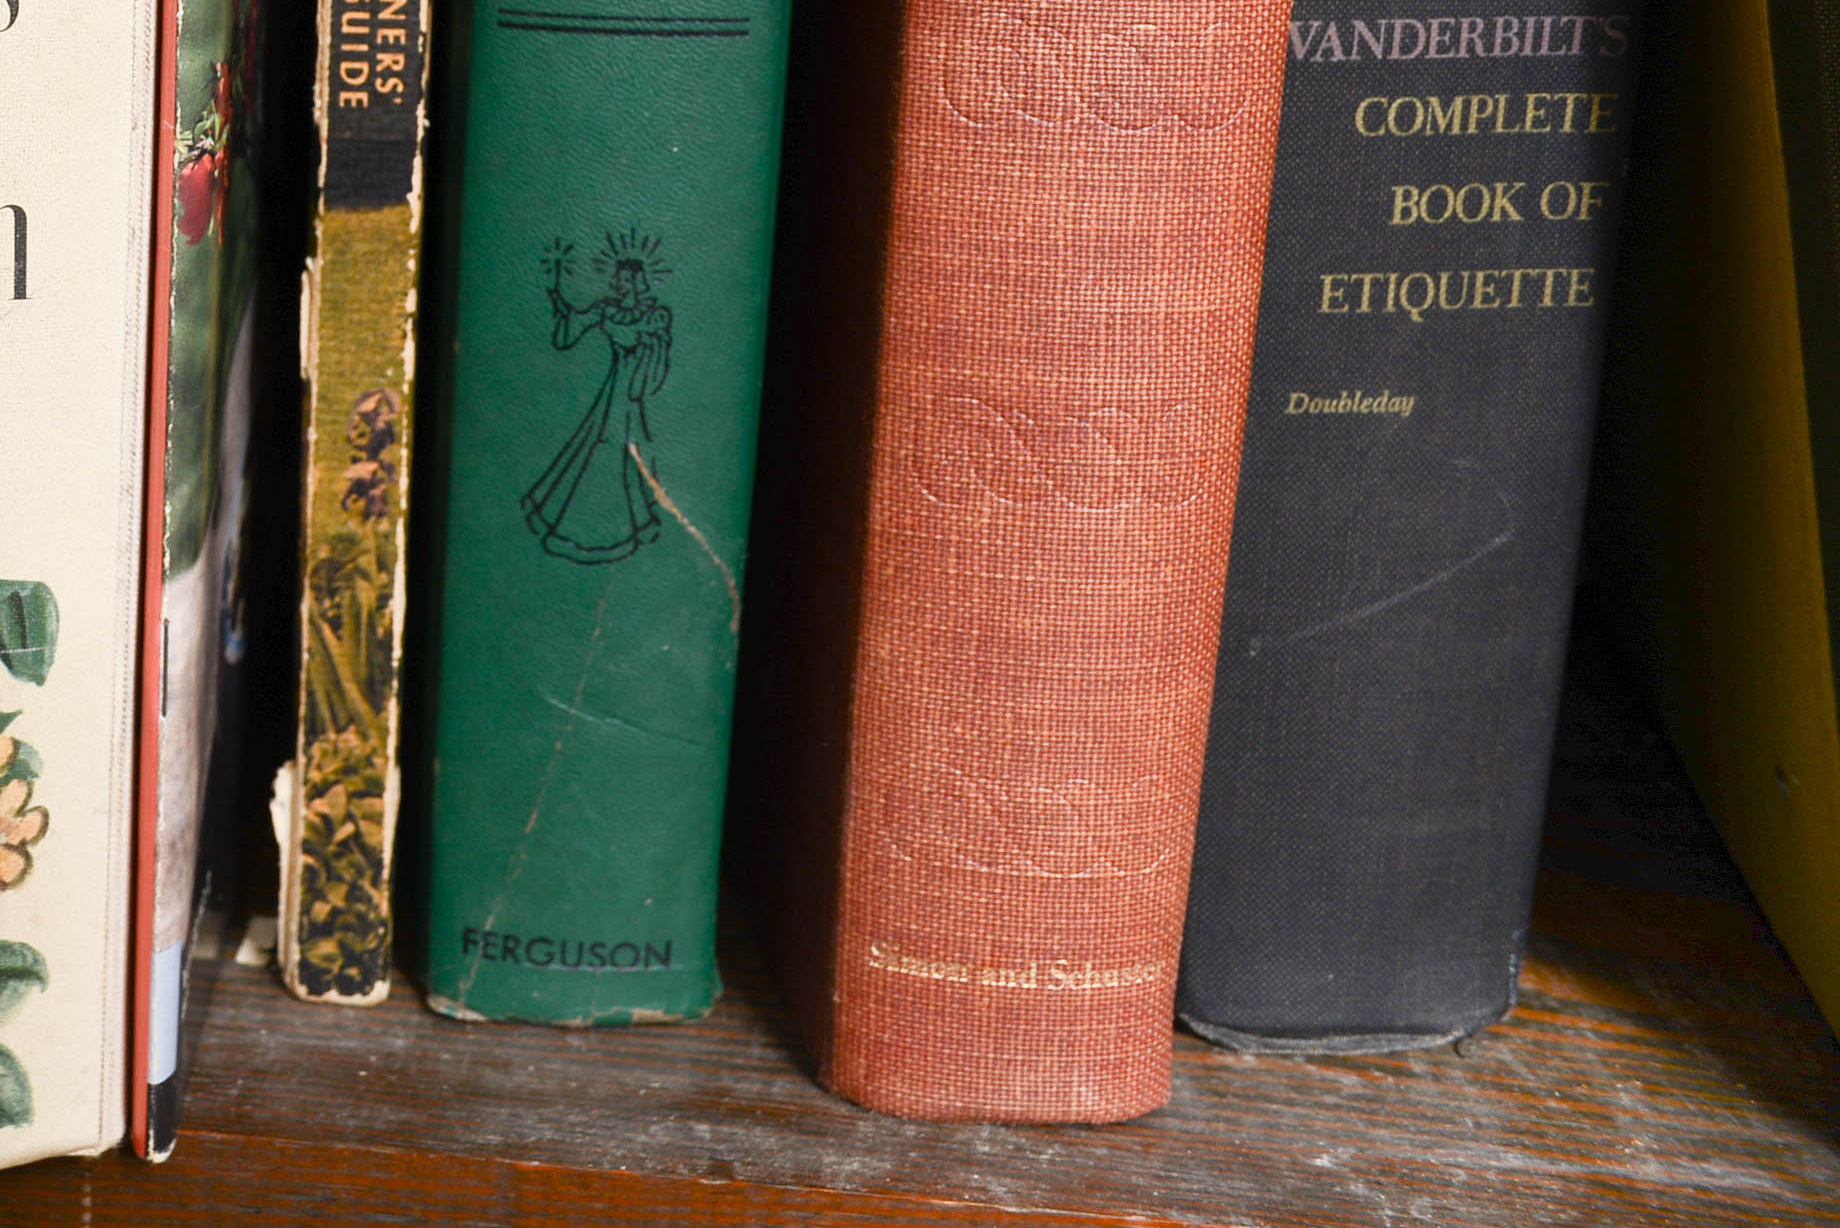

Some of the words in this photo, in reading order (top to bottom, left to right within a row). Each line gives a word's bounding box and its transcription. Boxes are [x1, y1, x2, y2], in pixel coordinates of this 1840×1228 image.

[1289, 15, 1630, 63] VANDERBILT'S
[1354, 93, 1619, 138] COMPLETE
[1388, 182, 1527, 226] BOOK
[1540, 181, 1610, 221] OF
[1317, 267, 1597, 323] ETIQUETTE
[1285, 391, 1416, 417] Doubleday
[462, 926, 673, 969] FERGUSON
[868, 938, 969, 983] Simon
[980, 960, 1038, 989] and
